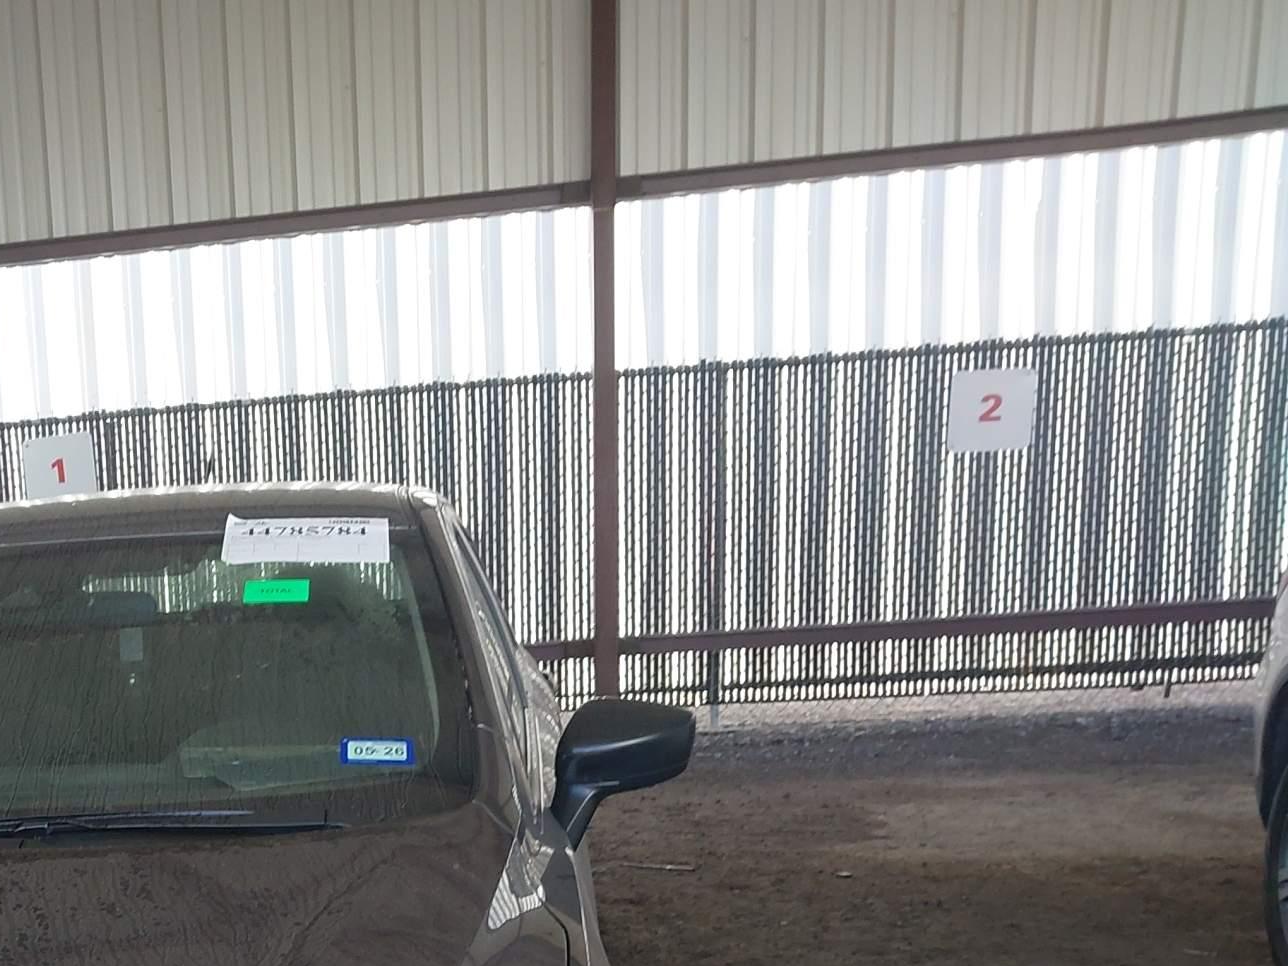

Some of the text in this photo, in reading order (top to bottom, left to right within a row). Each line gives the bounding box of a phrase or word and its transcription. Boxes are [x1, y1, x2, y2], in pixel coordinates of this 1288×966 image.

[978, 394, 1002, 422] 2
[51, 458, 65, 483] 1
[242, 526, 368, 536] 44785784
